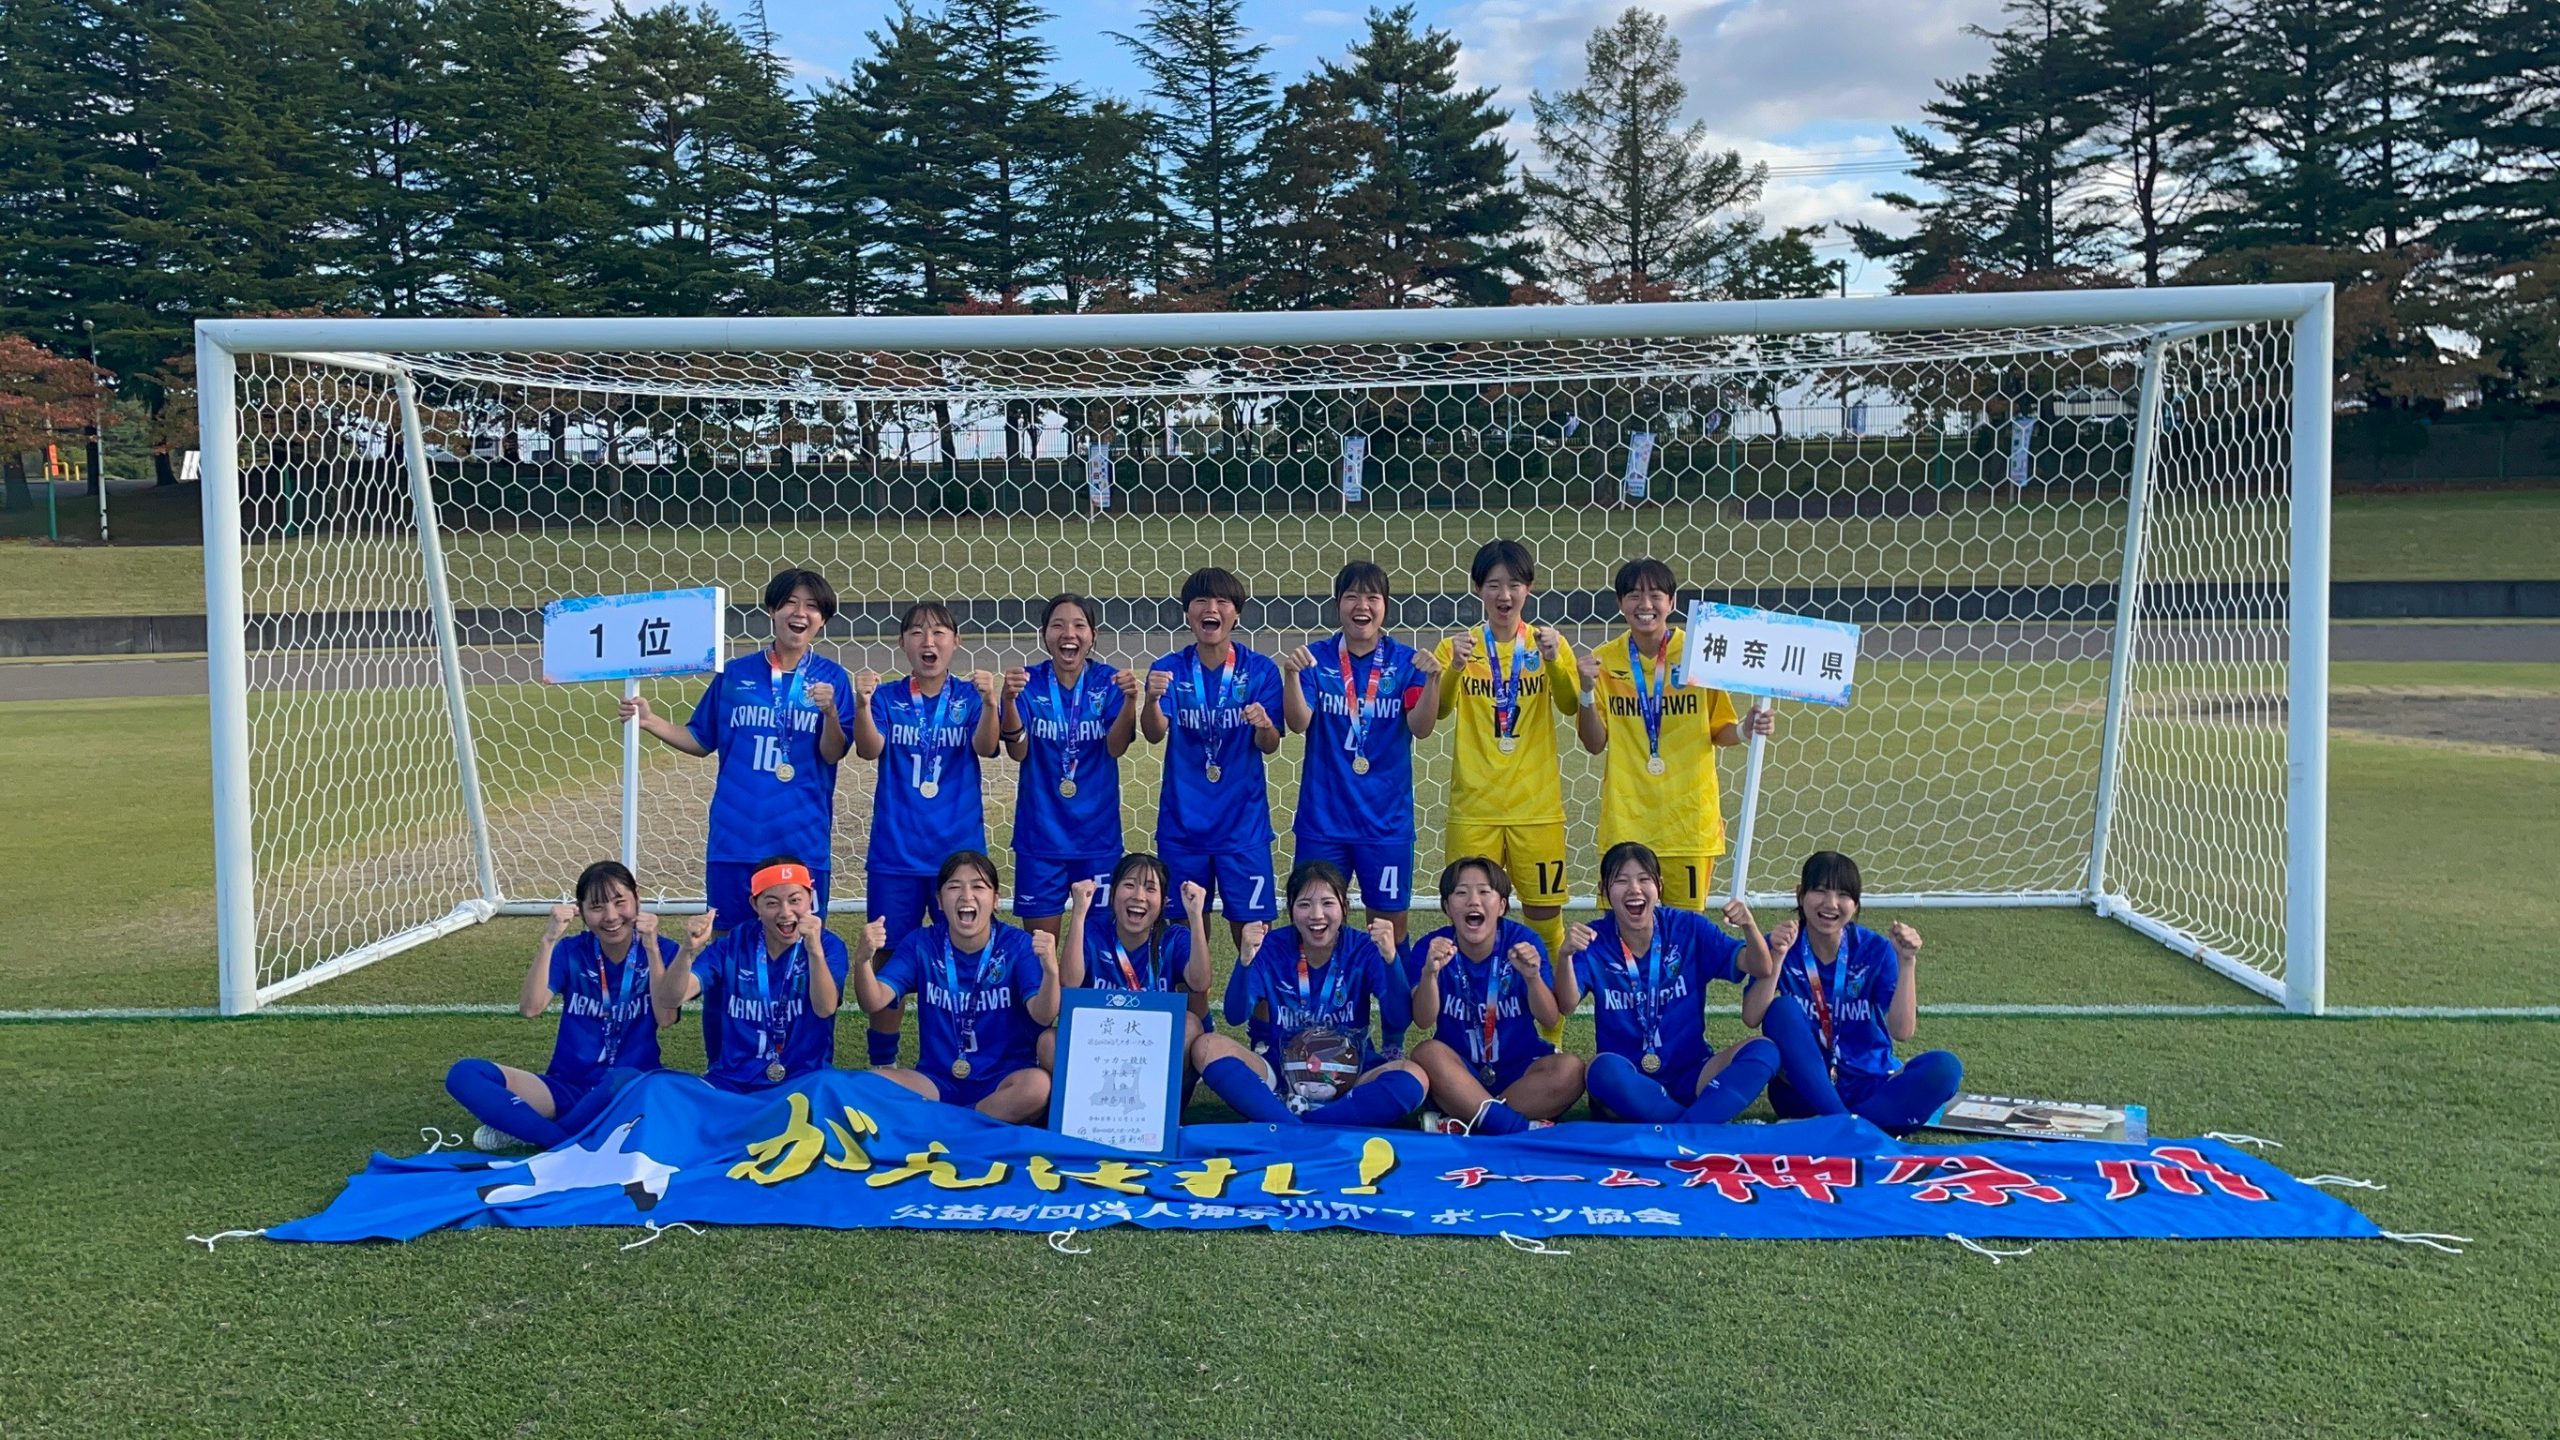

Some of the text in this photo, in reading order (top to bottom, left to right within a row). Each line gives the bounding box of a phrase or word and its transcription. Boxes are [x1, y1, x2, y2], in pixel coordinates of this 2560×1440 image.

[1703, 632, 1844, 681] 神奈川県
[1462, 674, 1545, 698] KANAWA
[1608, 694, 1698, 717] KANAWA
[752, 734, 783, 773] 16
[1249, 875, 1265, 910] 2
[1379, 866, 1399, 899] 4
[1536, 861, 1565, 895] 12
[1685, 865, 1698, 899] 1
[1099, 1017, 1143, 1036] 賞状
